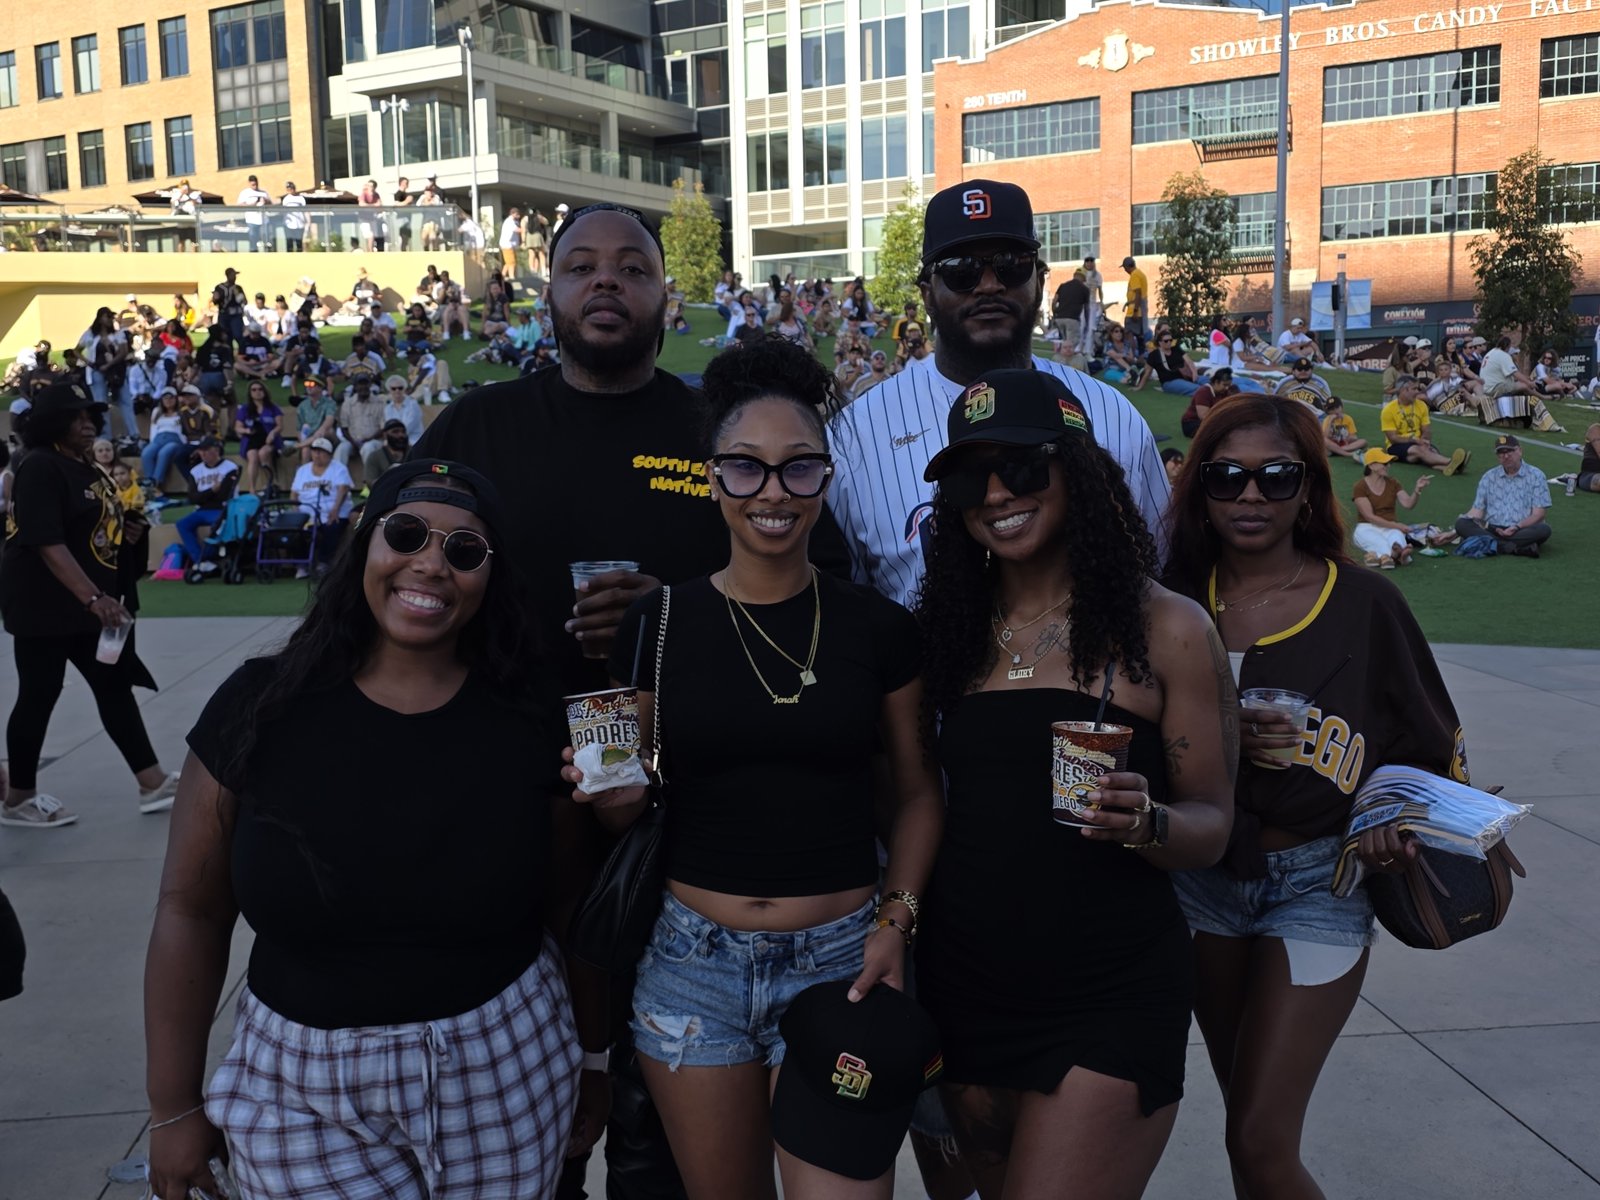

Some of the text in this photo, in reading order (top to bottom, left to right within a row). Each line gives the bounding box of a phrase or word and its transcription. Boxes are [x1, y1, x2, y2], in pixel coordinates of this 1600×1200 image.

[1189, 32, 1301, 64] SHOWLEY
[1325, 19, 1397, 46] BROS.
[1413, 4, 1503, 33] CANDY
[985, 88, 1027, 106] TENTH
[1445, 325, 1475, 335] ENTRANC
[632, 454, 690, 473] SOUTH
[575, 721, 639, 750] PADRES
